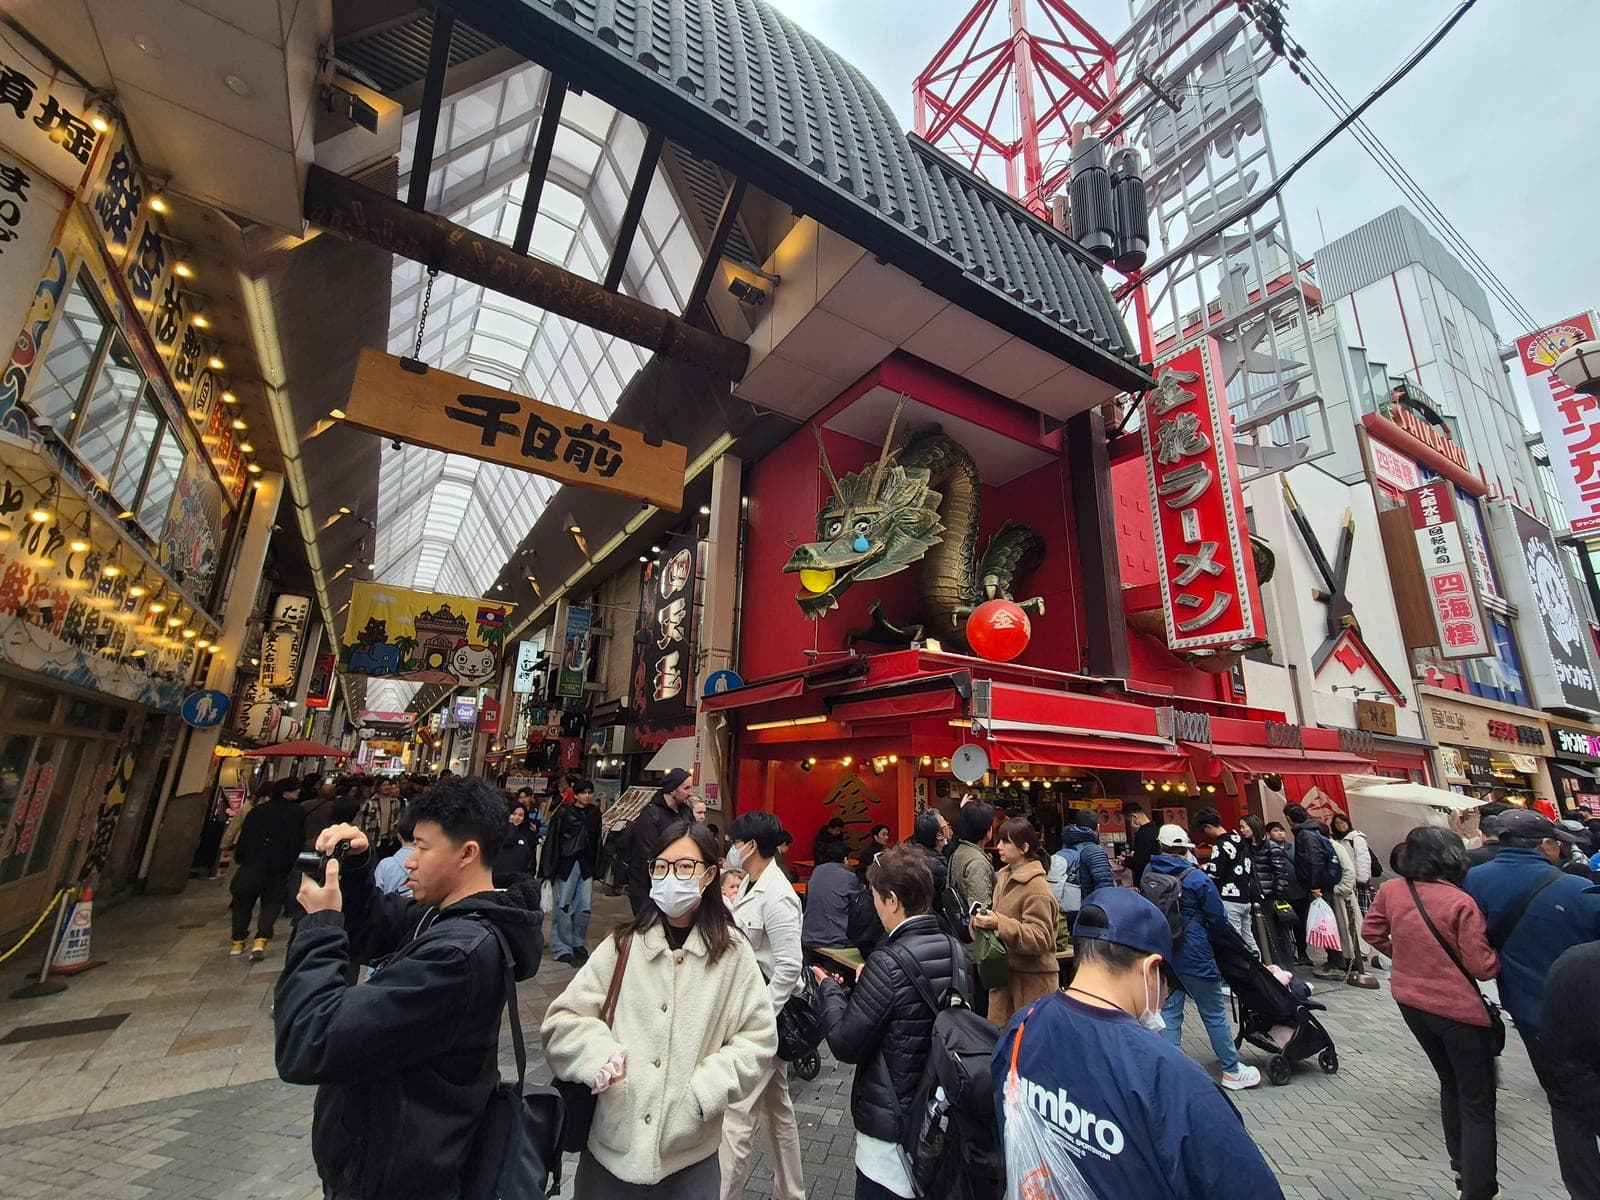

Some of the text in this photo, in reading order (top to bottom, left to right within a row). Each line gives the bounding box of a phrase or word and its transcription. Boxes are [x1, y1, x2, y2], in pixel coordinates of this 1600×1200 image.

[444, 393, 624, 478] 千日前
[1428, 526, 1451, 564] 回転寿司
[989, 608, 1019, 630] 金
